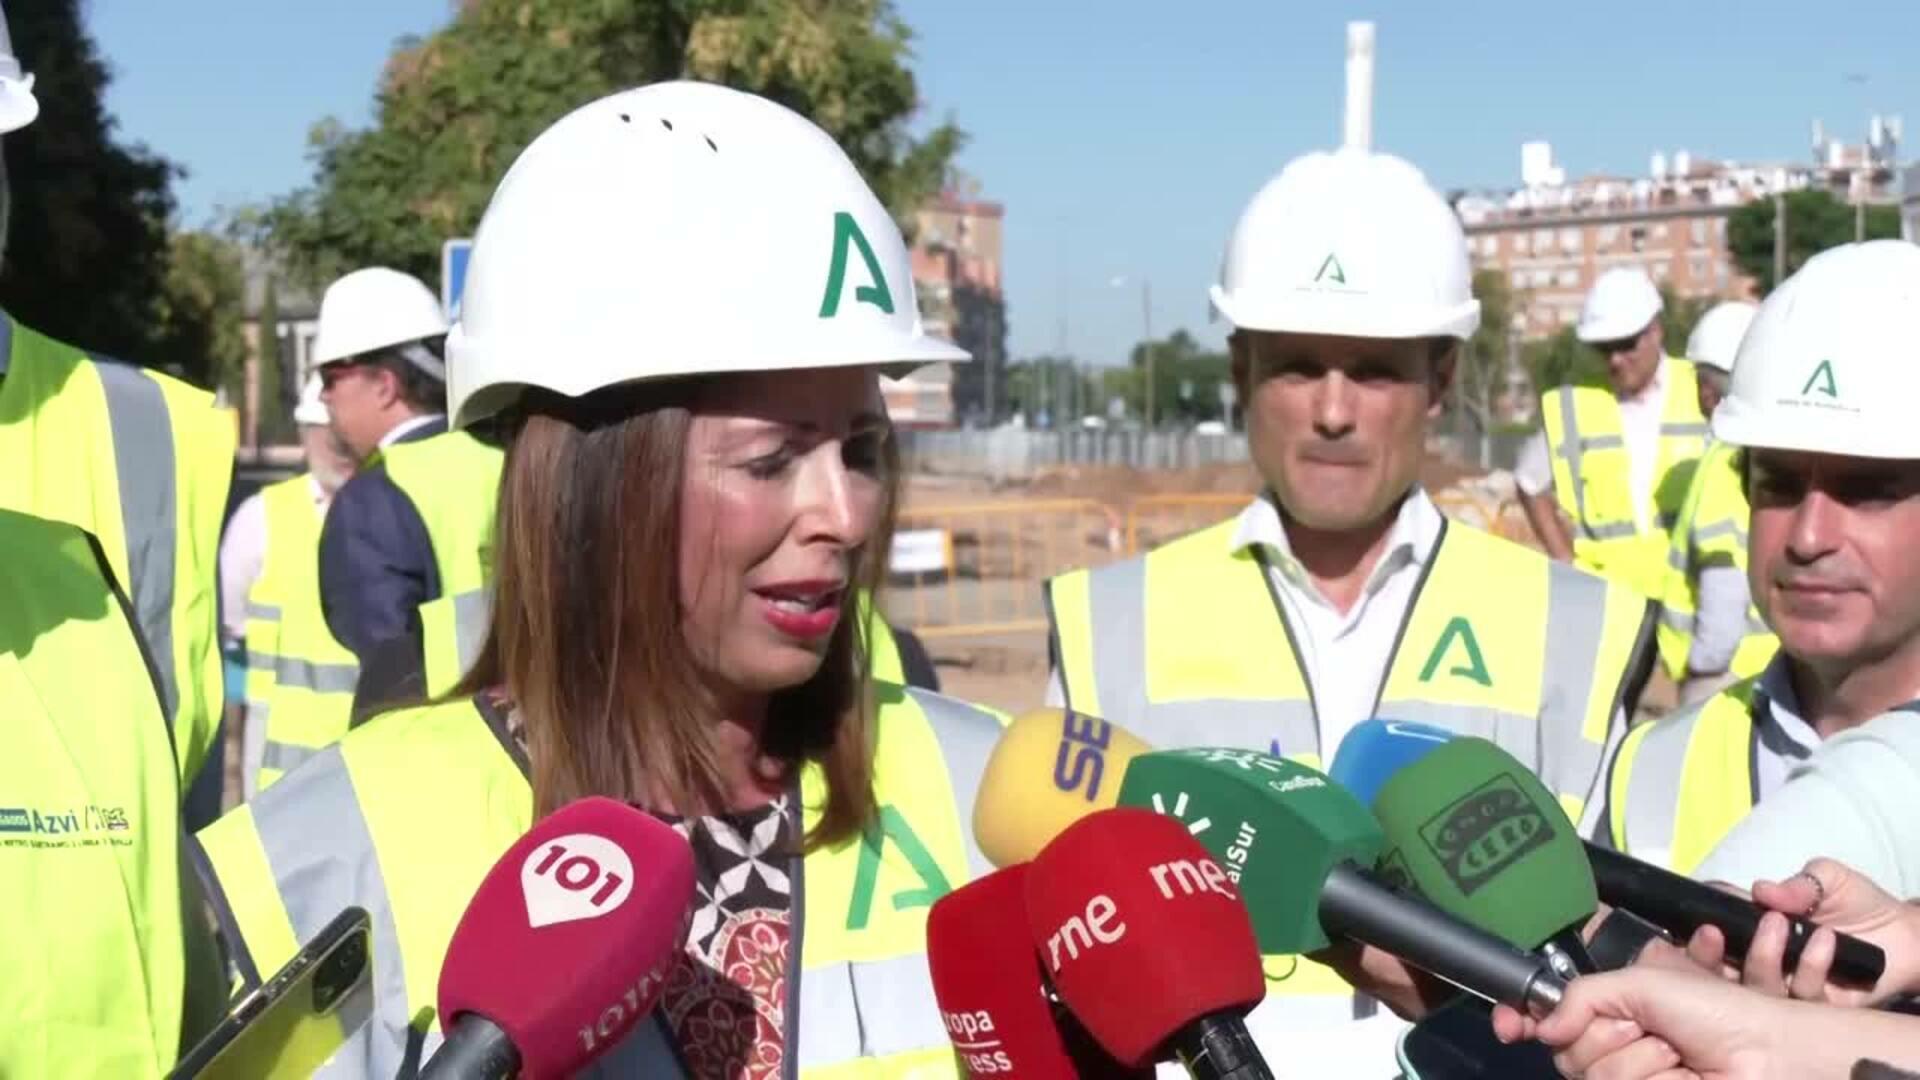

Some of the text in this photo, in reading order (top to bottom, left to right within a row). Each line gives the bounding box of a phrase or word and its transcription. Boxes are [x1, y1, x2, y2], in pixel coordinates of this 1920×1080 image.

[33, 809, 80, 833] Azvi
[1465, 816, 1533, 868] CERO
[534, 845, 623, 907] 101
[1149, 859, 1236, 900] rne
[1047, 895, 1126, 972] rne
